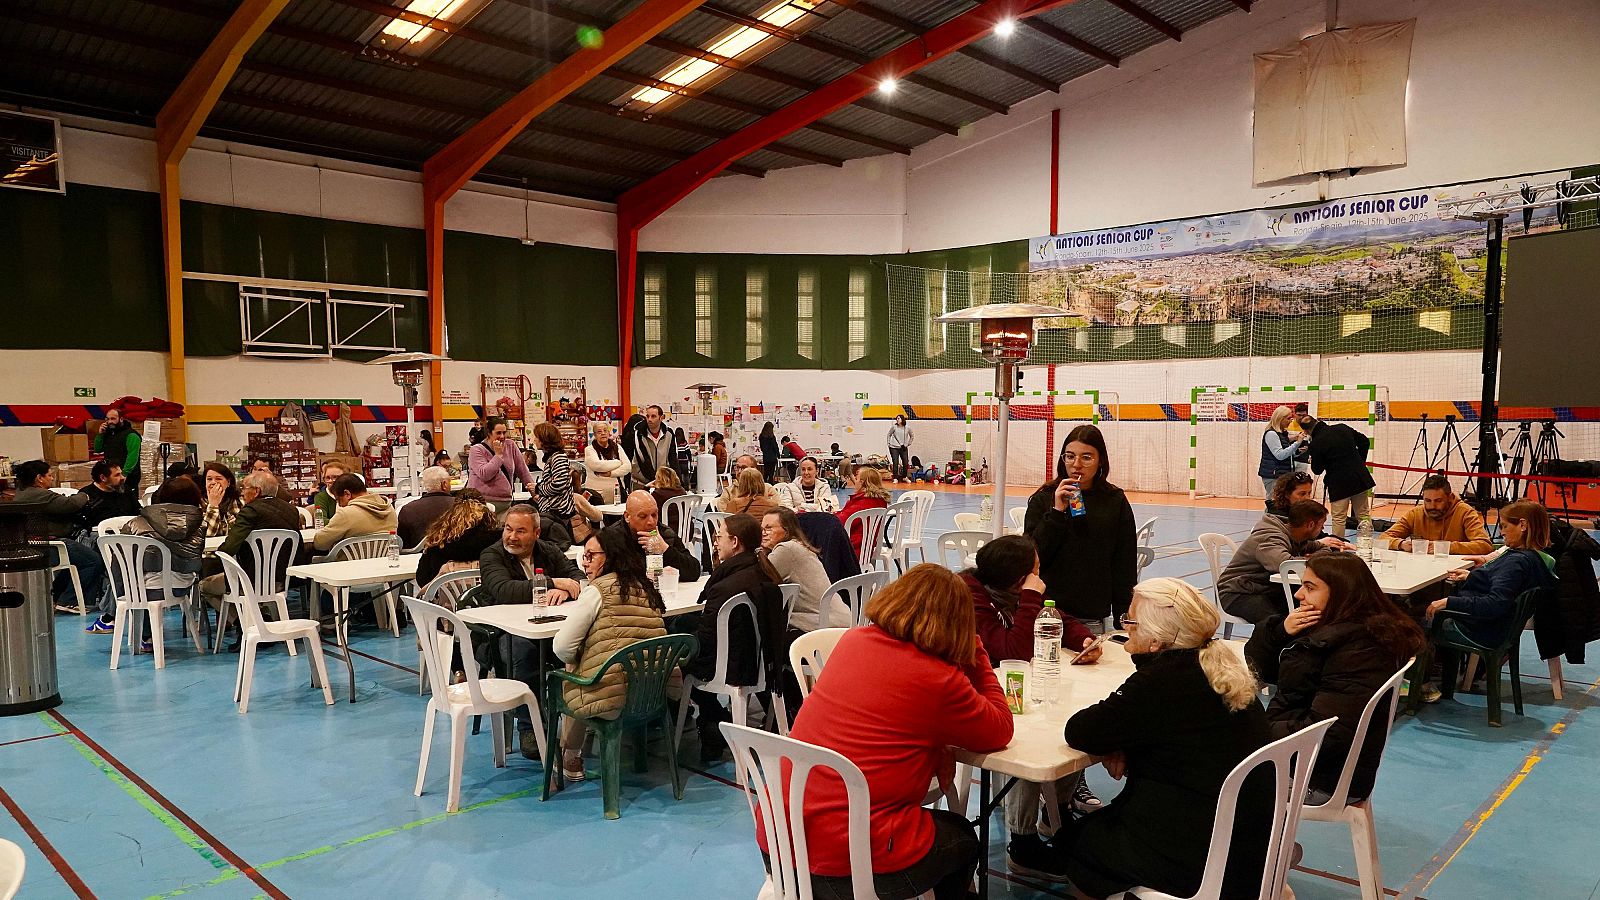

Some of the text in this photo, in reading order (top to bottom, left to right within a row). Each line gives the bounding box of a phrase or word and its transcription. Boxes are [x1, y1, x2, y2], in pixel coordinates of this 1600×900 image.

[11, 146, 49, 159] VISITANTE
[1293, 194, 1429, 224] NATIONS SENIOR CUP
[1387, 216, 1406, 226] June
[1408, 211, 1429, 223] 2025
[1056, 228, 1154, 250] NATIONS SENIOR CUP
